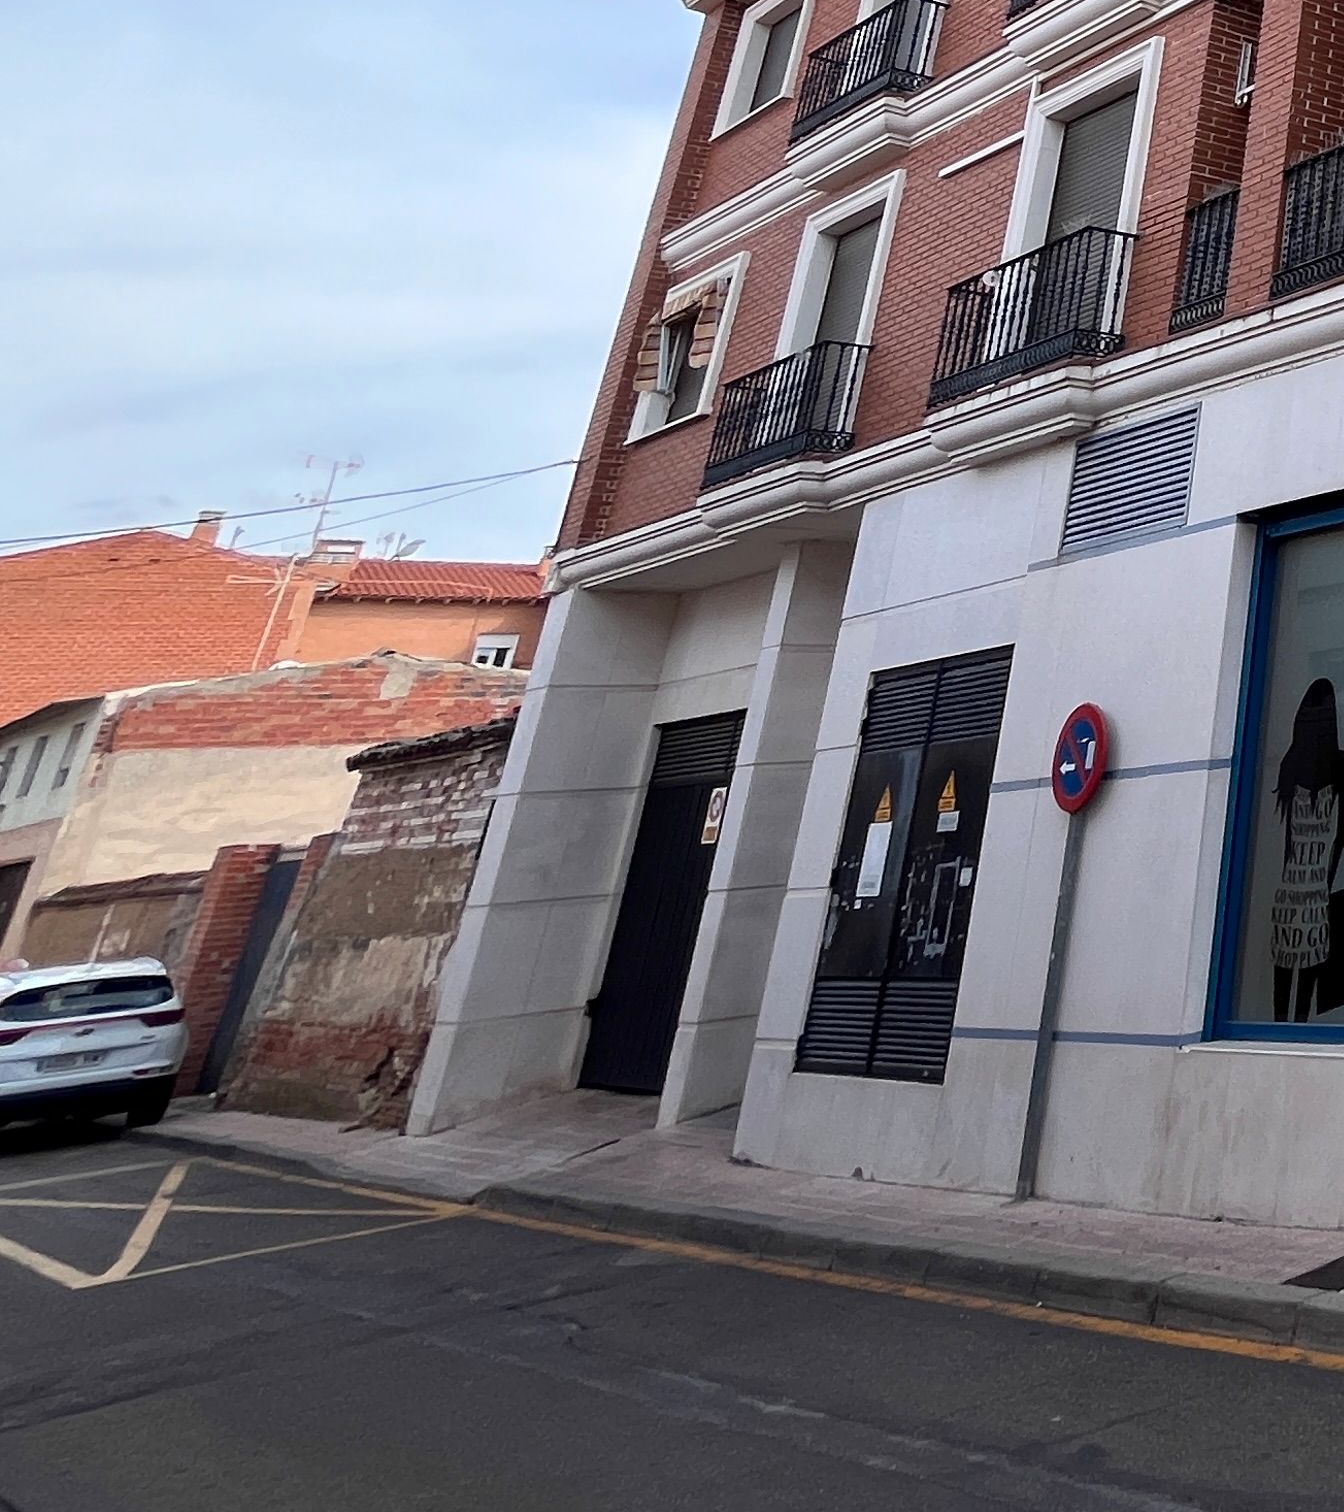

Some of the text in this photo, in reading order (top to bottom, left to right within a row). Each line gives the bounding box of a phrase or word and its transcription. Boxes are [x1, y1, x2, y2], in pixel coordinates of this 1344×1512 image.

[1289, 840, 1326, 865] KEEP
[1271, 906, 1297, 924] KEEP
[1271, 922, 1329, 948] AND GO
